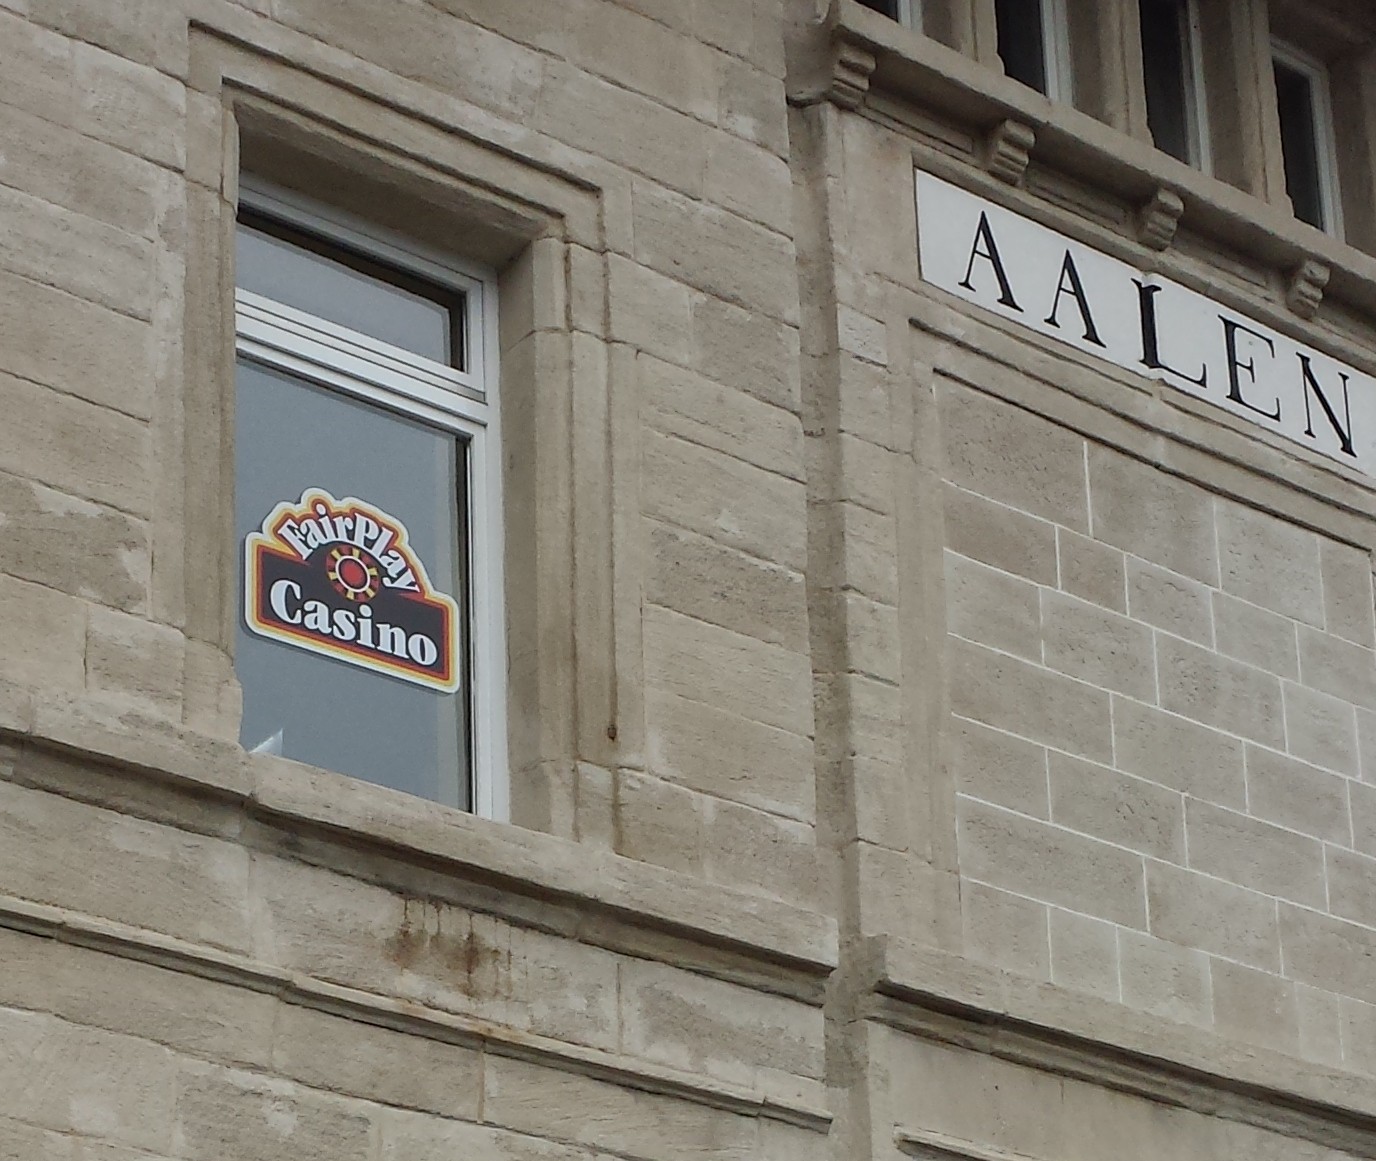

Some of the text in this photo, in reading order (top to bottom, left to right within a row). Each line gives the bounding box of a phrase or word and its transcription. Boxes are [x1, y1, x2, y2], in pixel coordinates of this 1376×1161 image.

[957, 210, 1358, 458] AALEN
[277, 503, 421, 593] FairPlay
[270, 579, 438, 666] Casino
